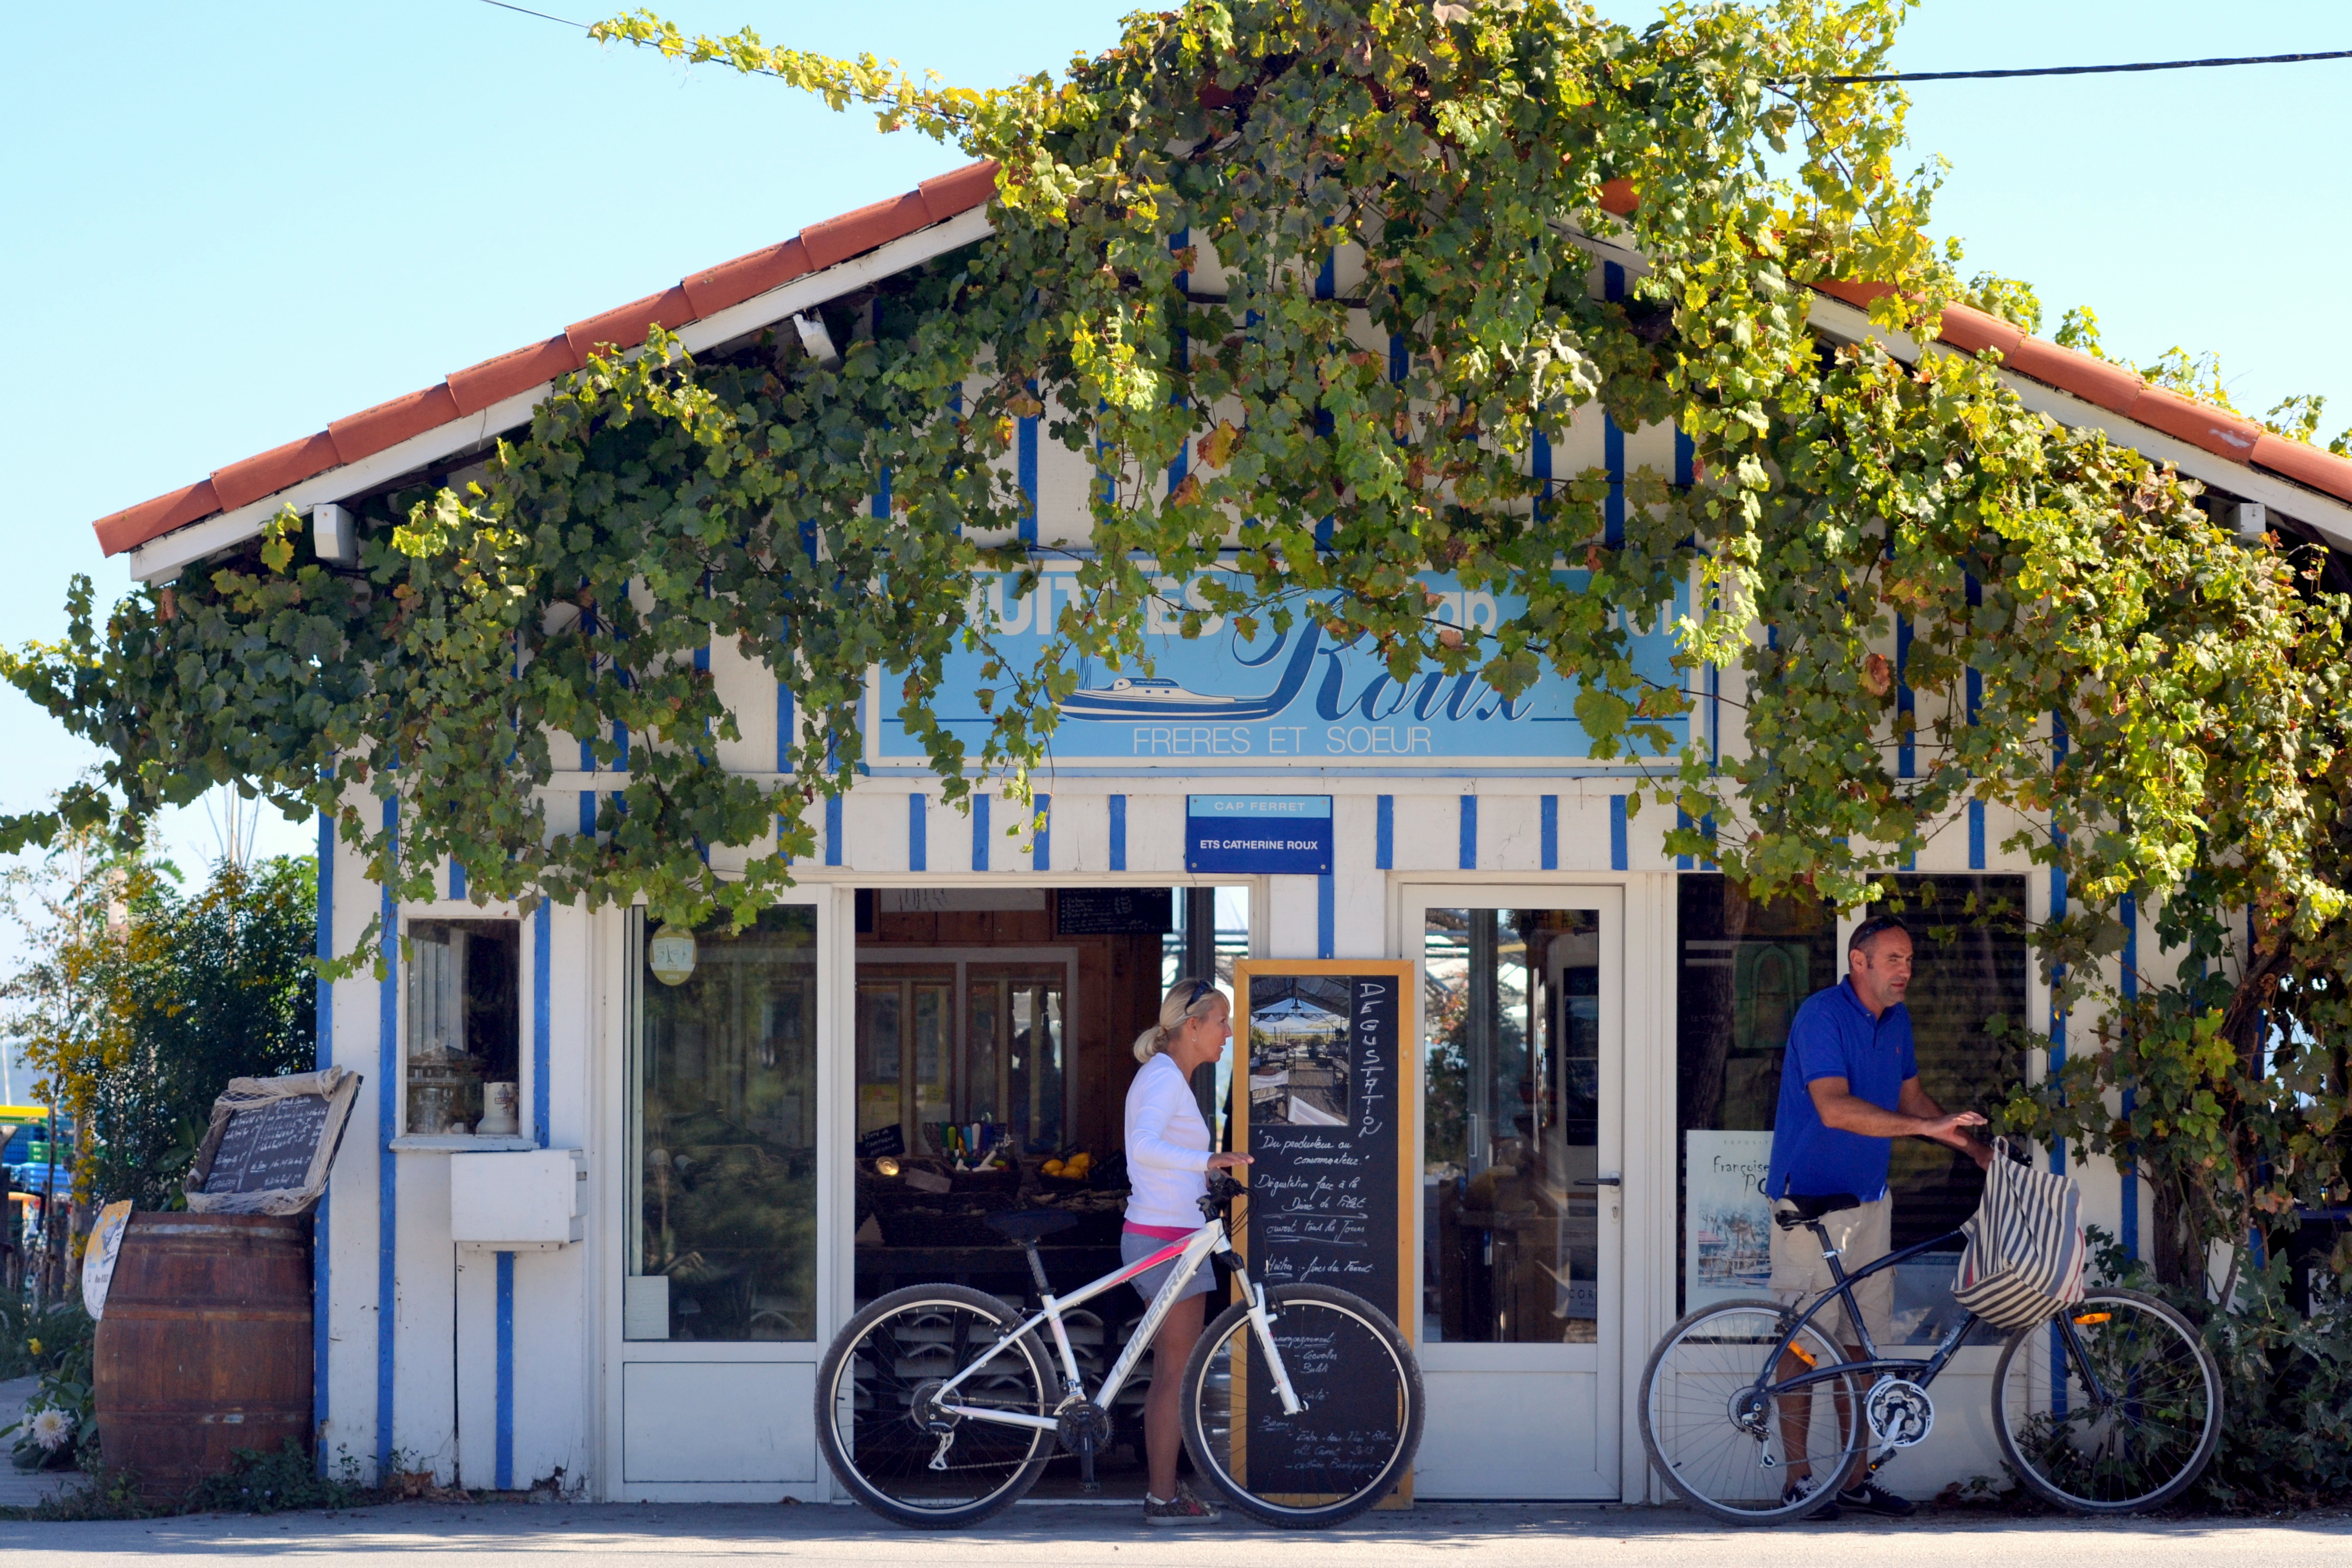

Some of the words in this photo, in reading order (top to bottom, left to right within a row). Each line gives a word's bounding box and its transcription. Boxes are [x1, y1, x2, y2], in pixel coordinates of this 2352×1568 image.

[936, 576, 1225, 636] HUITES
[1133, 726, 1251, 754] FRERES
[1269, 726, 1307, 754] ET
[1327, 726, 1431, 754] SOEUR
[1214, 801, 1244, 811] CAP
[1251, 802, 1306, 811] FERRET
[1200, 840, 1220, 849] ETS
[1222, 840, 1284, 849] CATHERINE
[1287, 841, 1318, 850] ROUX
[1713, 1155, 1770, 1178] Françoise
[1310, 1175, 1334, 1200] face
[1349, 1177, 1361, 1188] la
[1115, 1257, 1191, 1378] LAPIERRE
